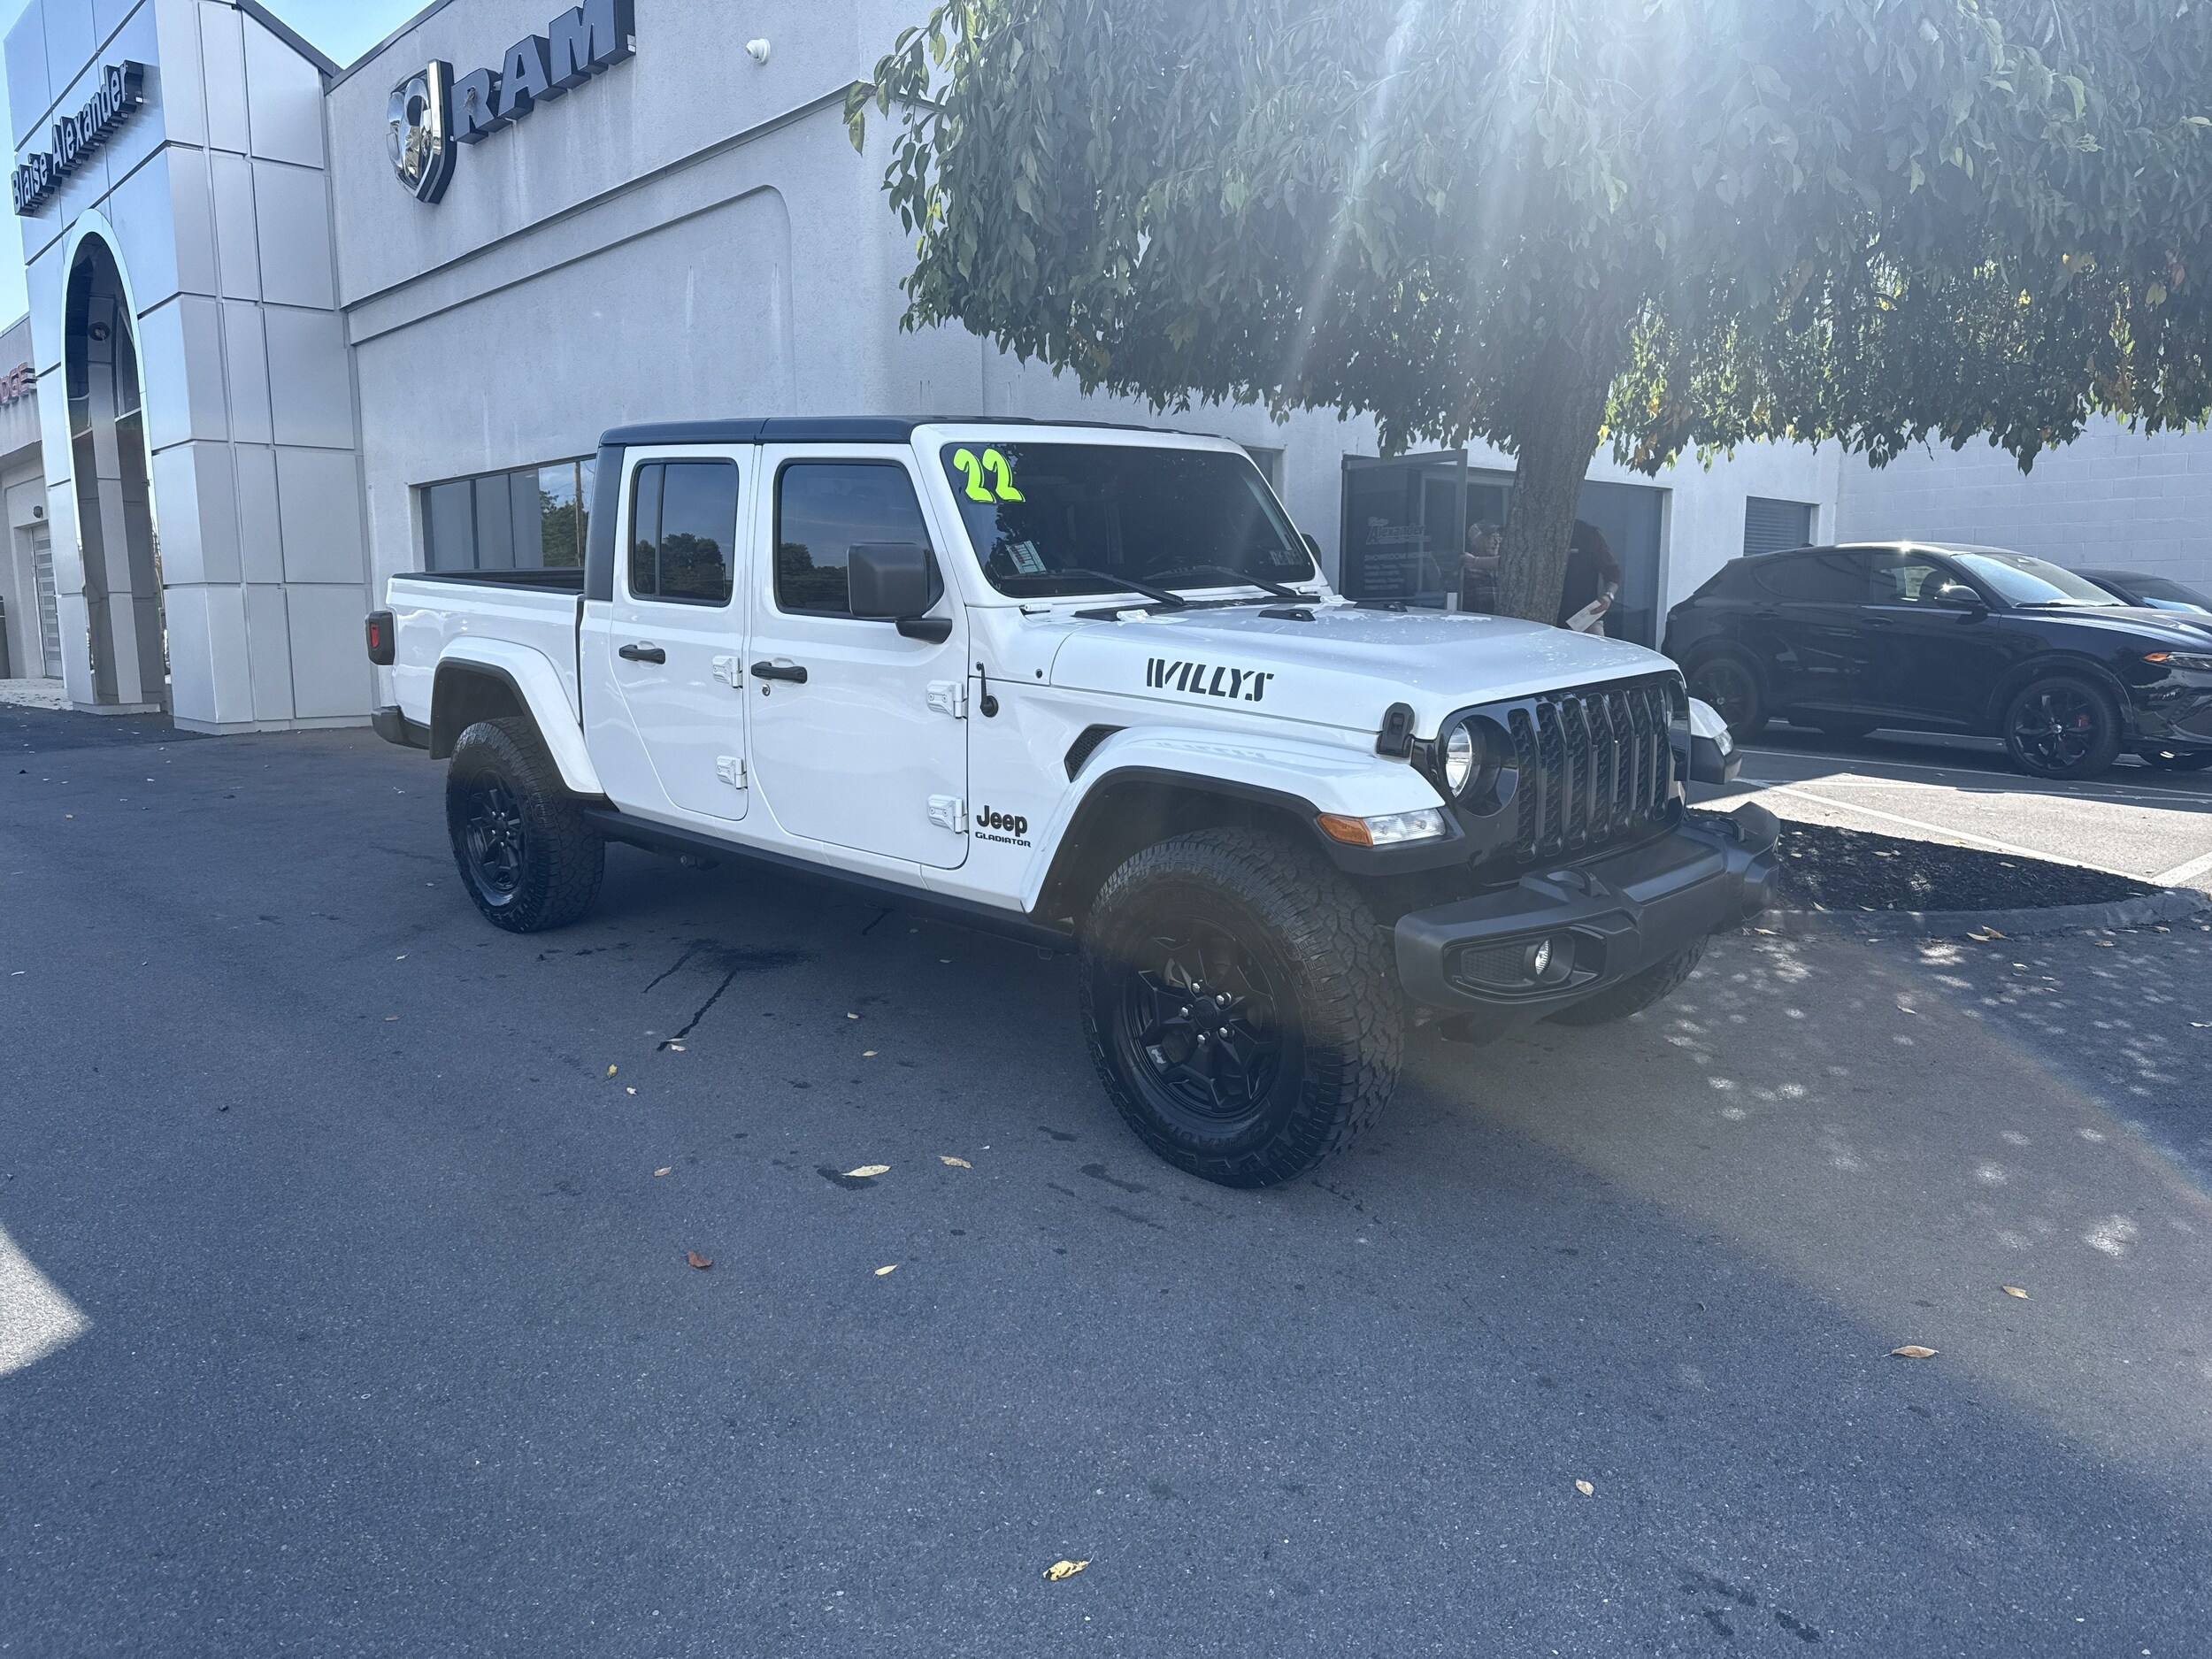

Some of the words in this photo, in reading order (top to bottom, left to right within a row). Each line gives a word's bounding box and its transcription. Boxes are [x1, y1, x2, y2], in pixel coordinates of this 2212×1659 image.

[451, 0, 617, 142] RAM
[11, 152, 50, 215] Blaise
[52, 60, 129, 177] Alexander
[0, 362, 29, 403] DGE
[953, 448, 1025, 503] 22
[1147, 657, 1274, 702] WILLYS
[975, 831, 1031, 848] GLADIATOR
[976, 804, 1028, 837] Jeep
